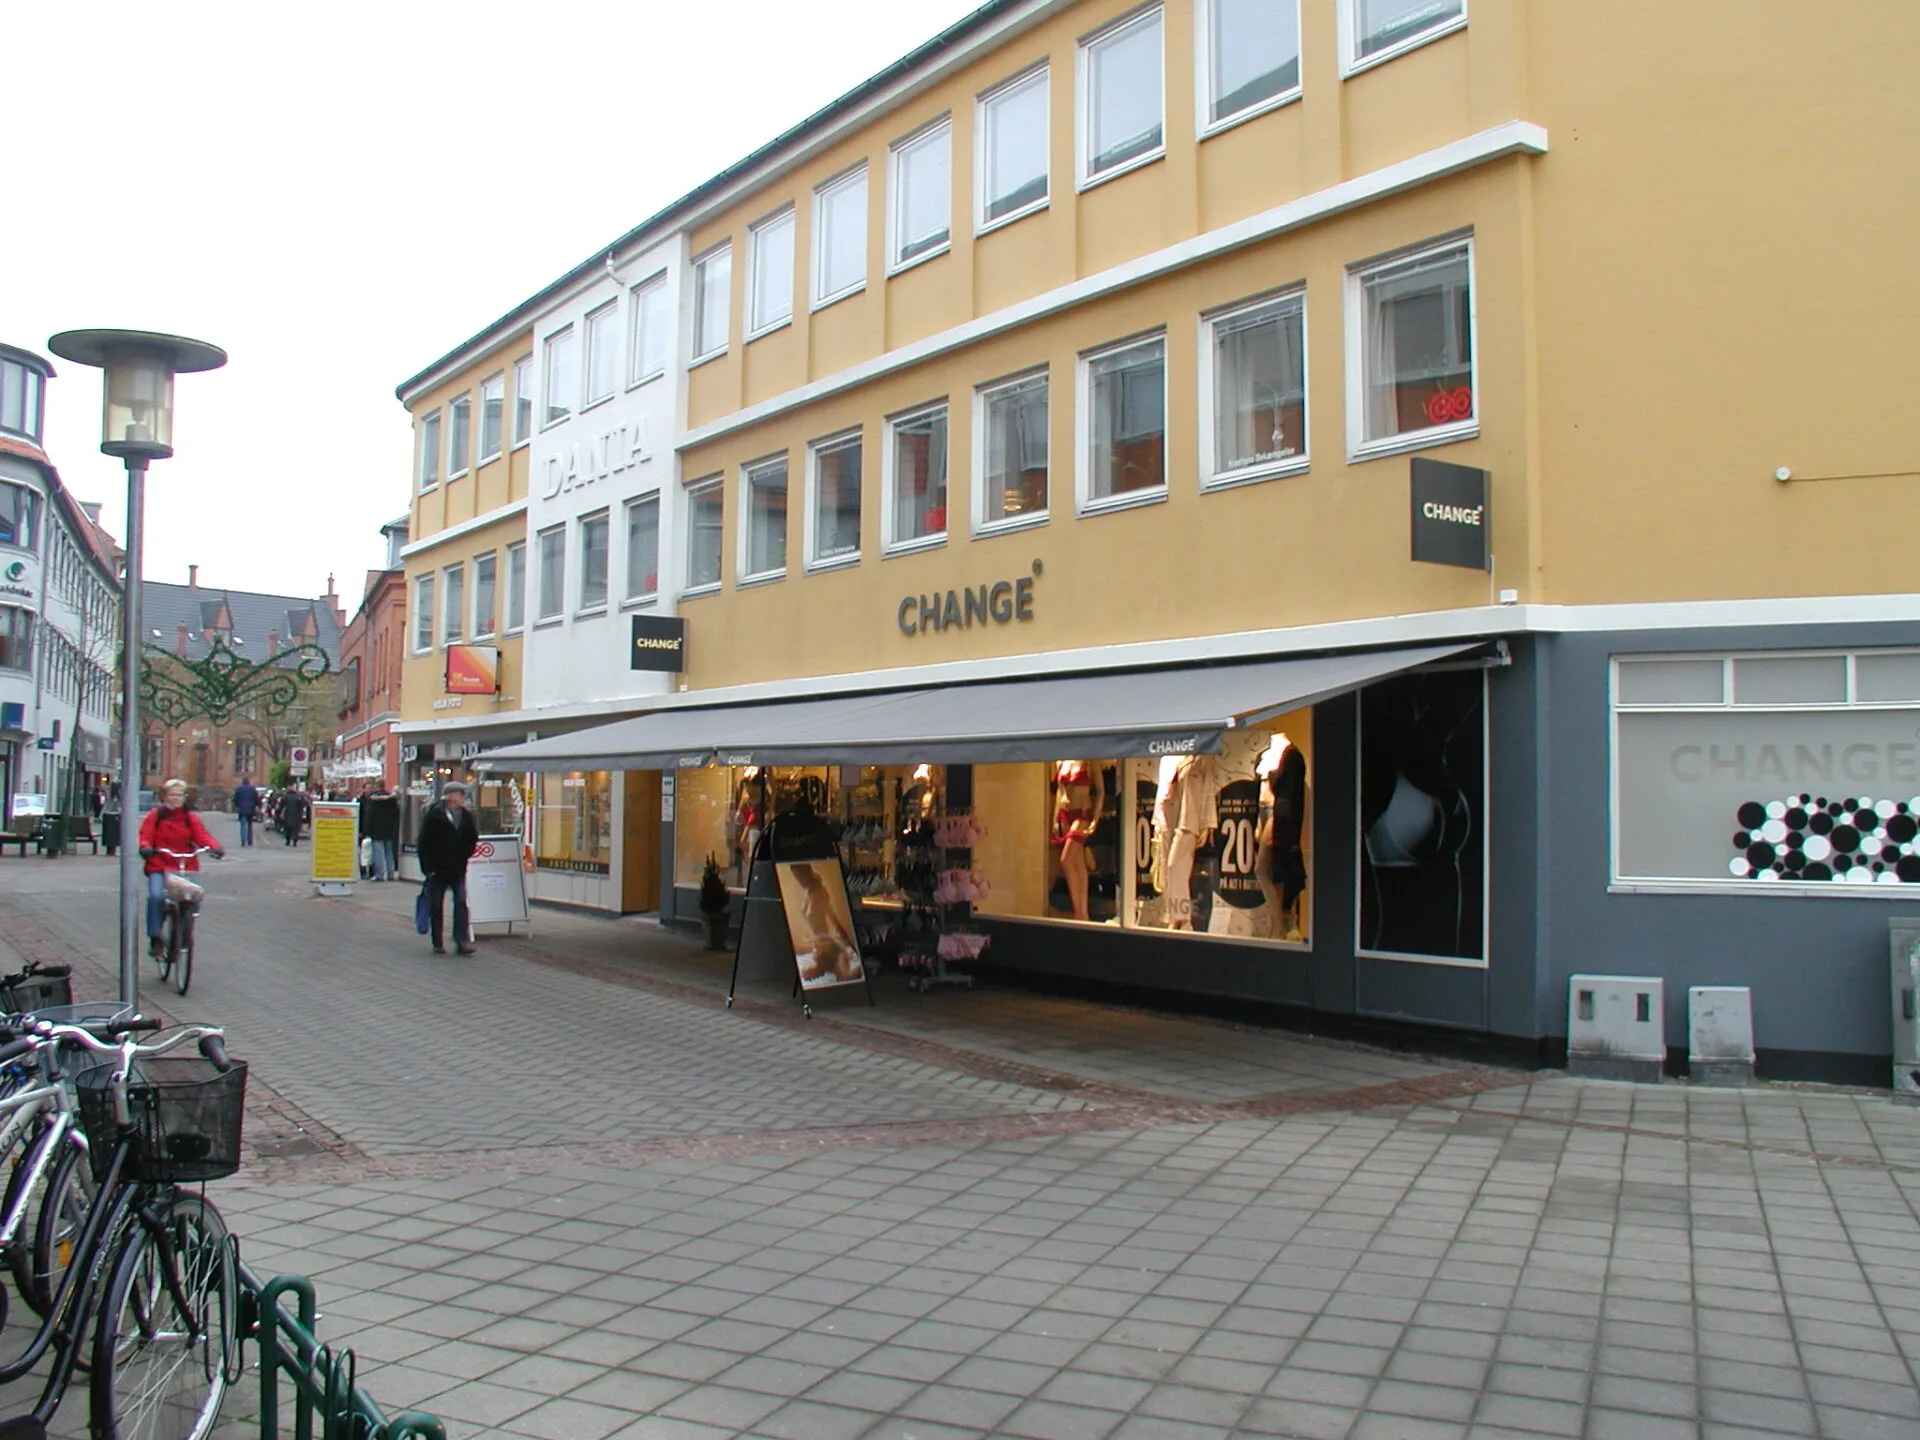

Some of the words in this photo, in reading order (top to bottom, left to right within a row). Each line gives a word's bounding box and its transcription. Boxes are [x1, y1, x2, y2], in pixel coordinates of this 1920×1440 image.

[1423, 502, 1481, 525] CHANGE
[898, 576, 1035, 636] CHANGE
[637, 637, 680, 650] CHANGE
[1149, 739, 1196, 753] CHANGE
[1670, 743, 1916, 784] CHANGE
[1221, 818, 1254, 874] 20
